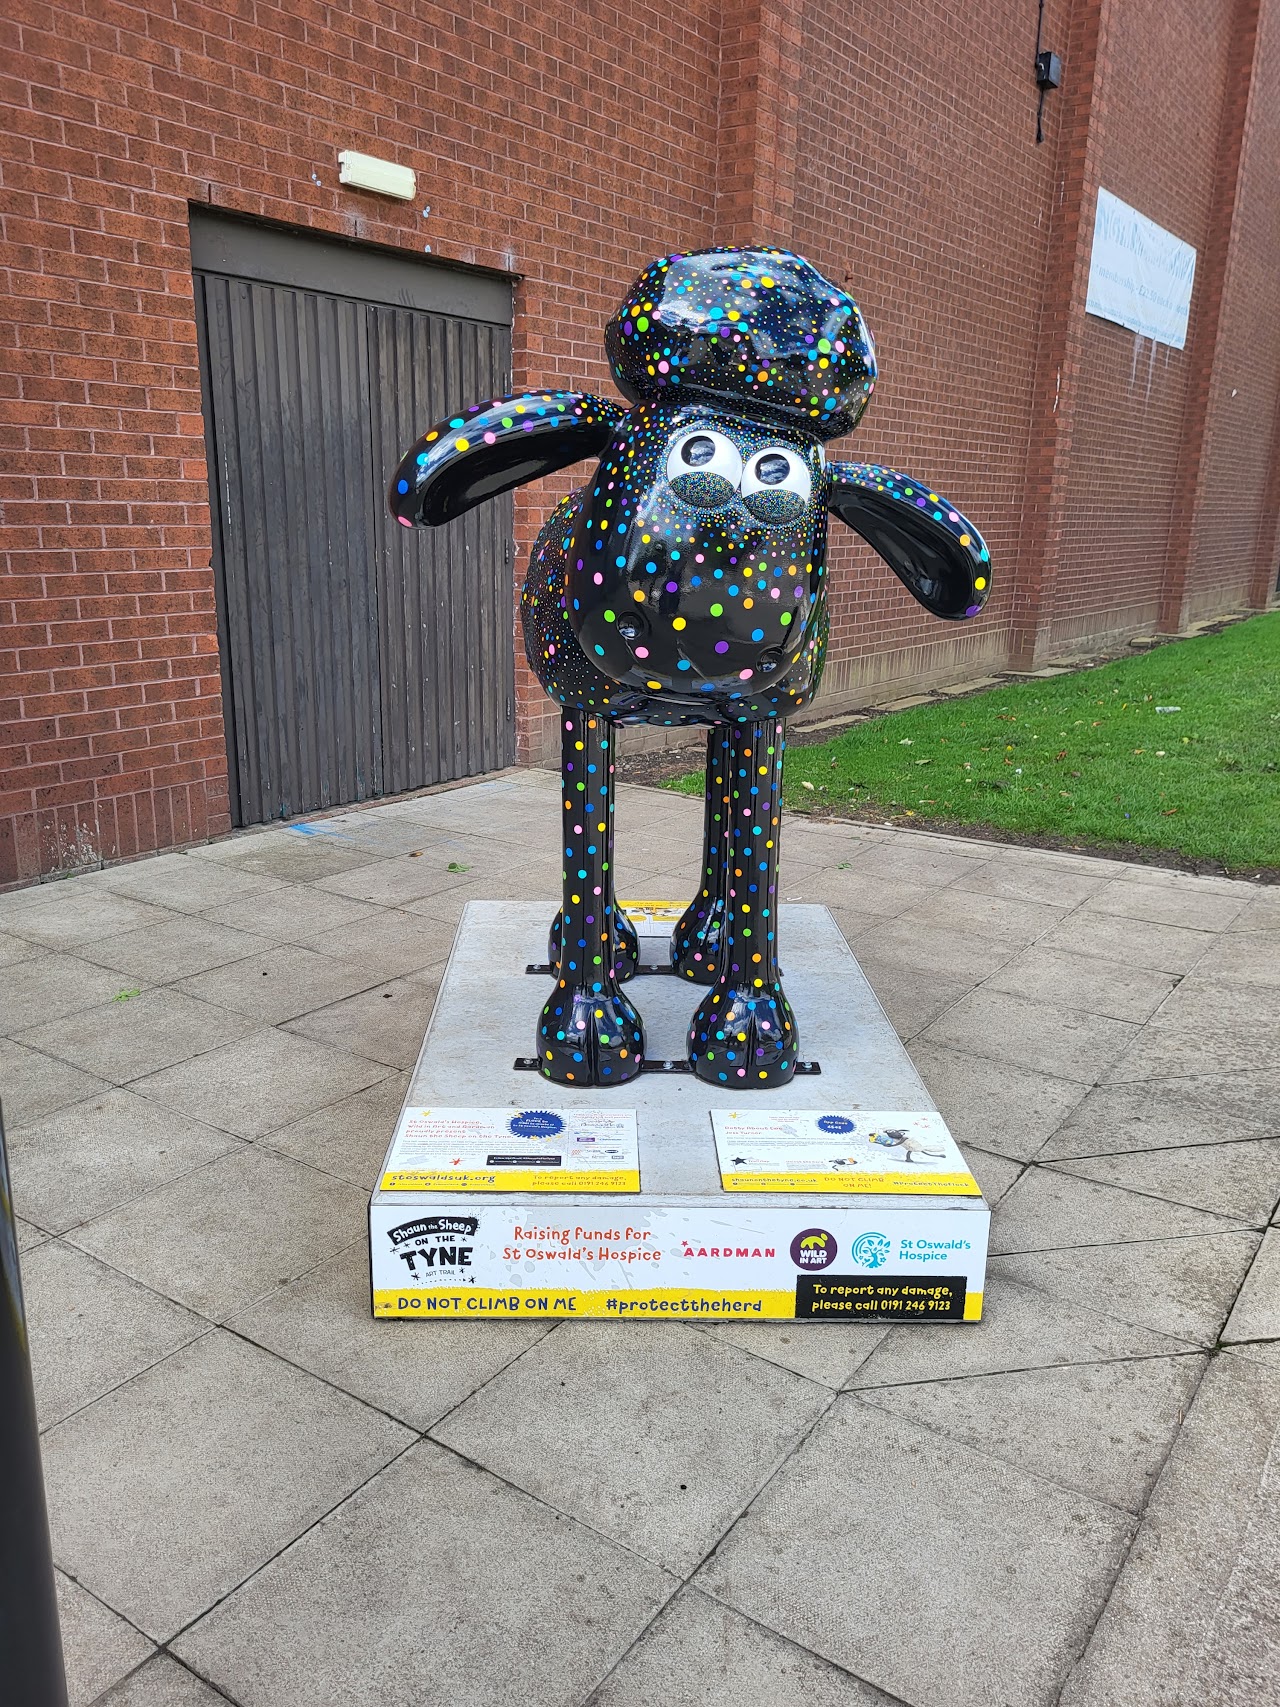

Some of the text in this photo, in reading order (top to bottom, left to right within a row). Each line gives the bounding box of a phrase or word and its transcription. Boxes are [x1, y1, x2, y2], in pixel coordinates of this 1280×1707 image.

[392, 1174, 496, 1183] stoswaldsuk.org
[393, 1224, 428, 1242] Shaun
[438, 1219, 472, 1234] Sheep
[514, 1226, 570, 1245] Raising
[625, 1227, 651, 1240] for
[415, 1237, 429, 1246] ON
[900, 1239, 971, 1250] St Oswald's
[400, 1246, 474, 1271] TYNE
[503, 1247, 661, 1263] St Oswald's Hospice
[683, 1247, 776, 1258] AARDMAN
[800, 1249, 828, 1258] WILD
[899, 1250, 948, 1262] Hospice
[812, 1284, 953, 1300] To report any damage,
[398, 1297, 576, 1310] DO NOT CLIMB ON ME
[606, 1298, 762, 1314] #protecttheherd
[812, 1300, 950, 1312] please call 0191 246 9123
